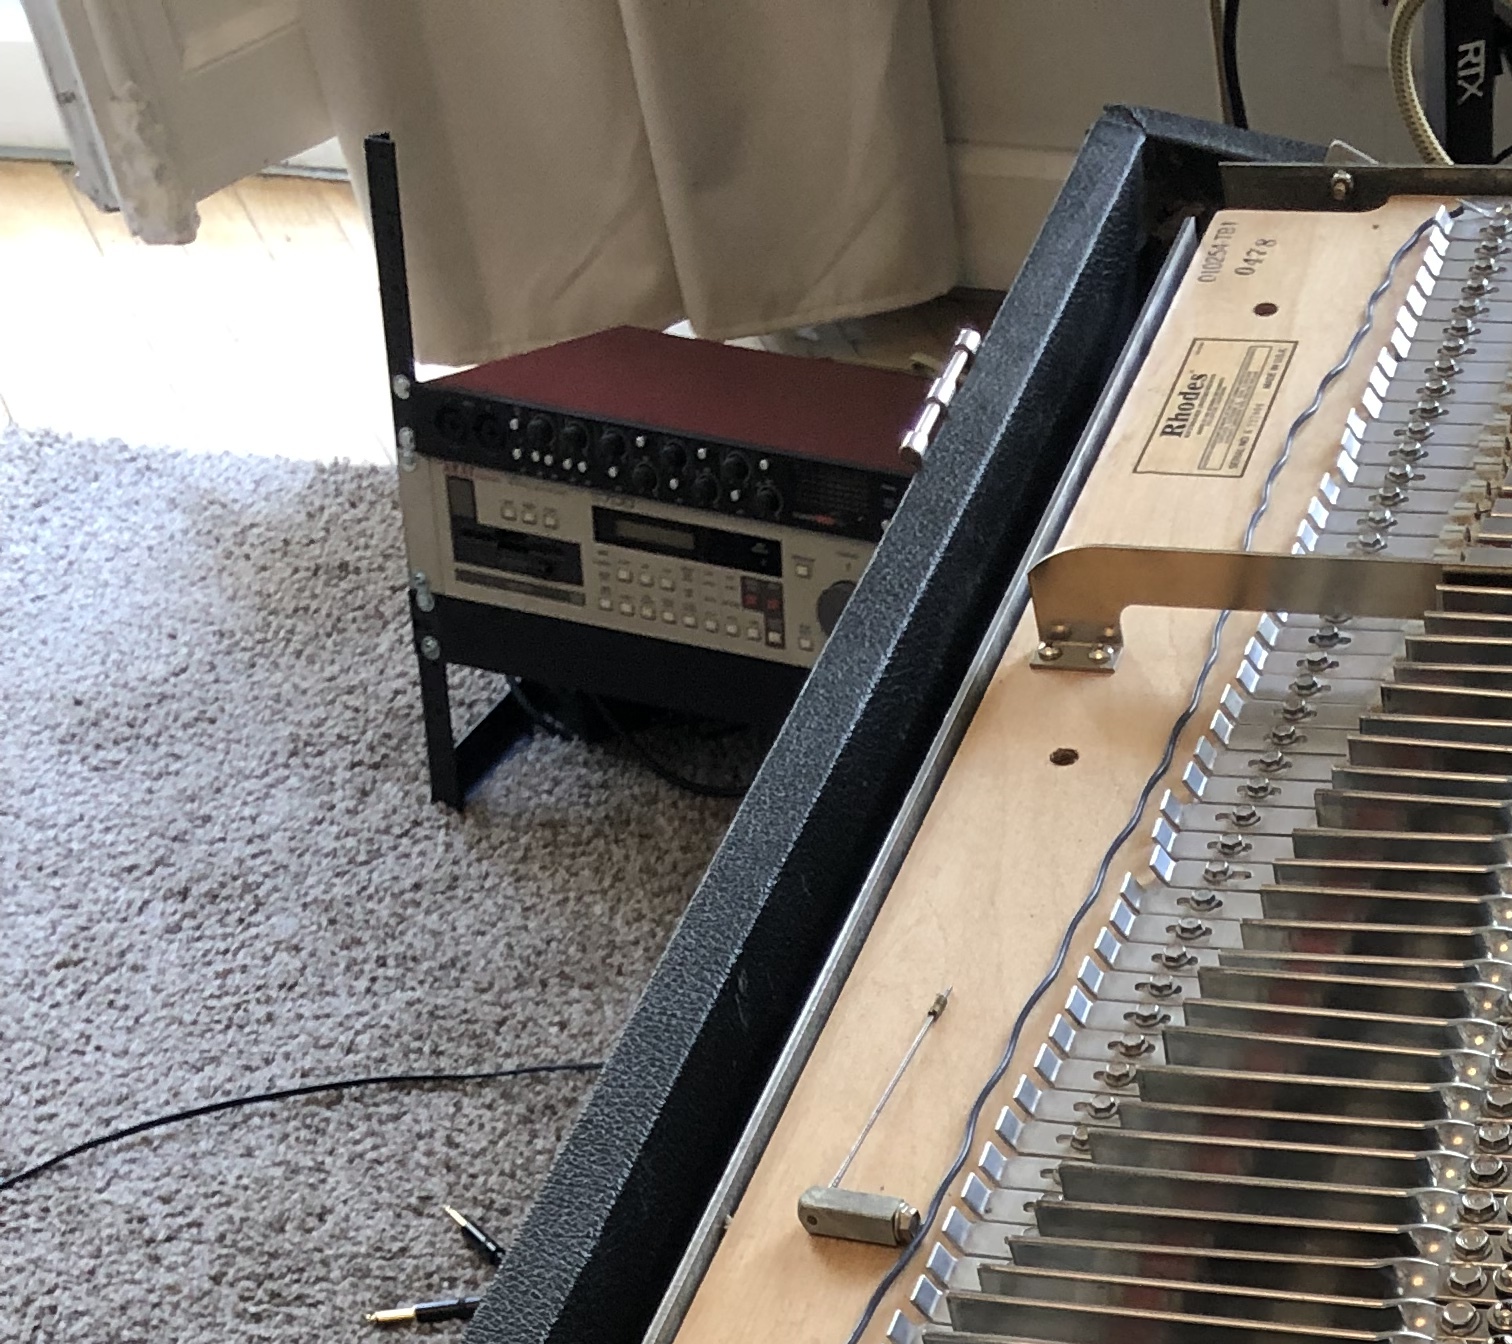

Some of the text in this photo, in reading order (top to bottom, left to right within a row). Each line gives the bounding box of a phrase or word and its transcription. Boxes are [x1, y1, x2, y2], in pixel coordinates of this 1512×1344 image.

[1457, 39, 1486, 105] RTX
[1234, 238, 1277, 276] 0478
[1159, 373, 1209, 438] Rhodes
